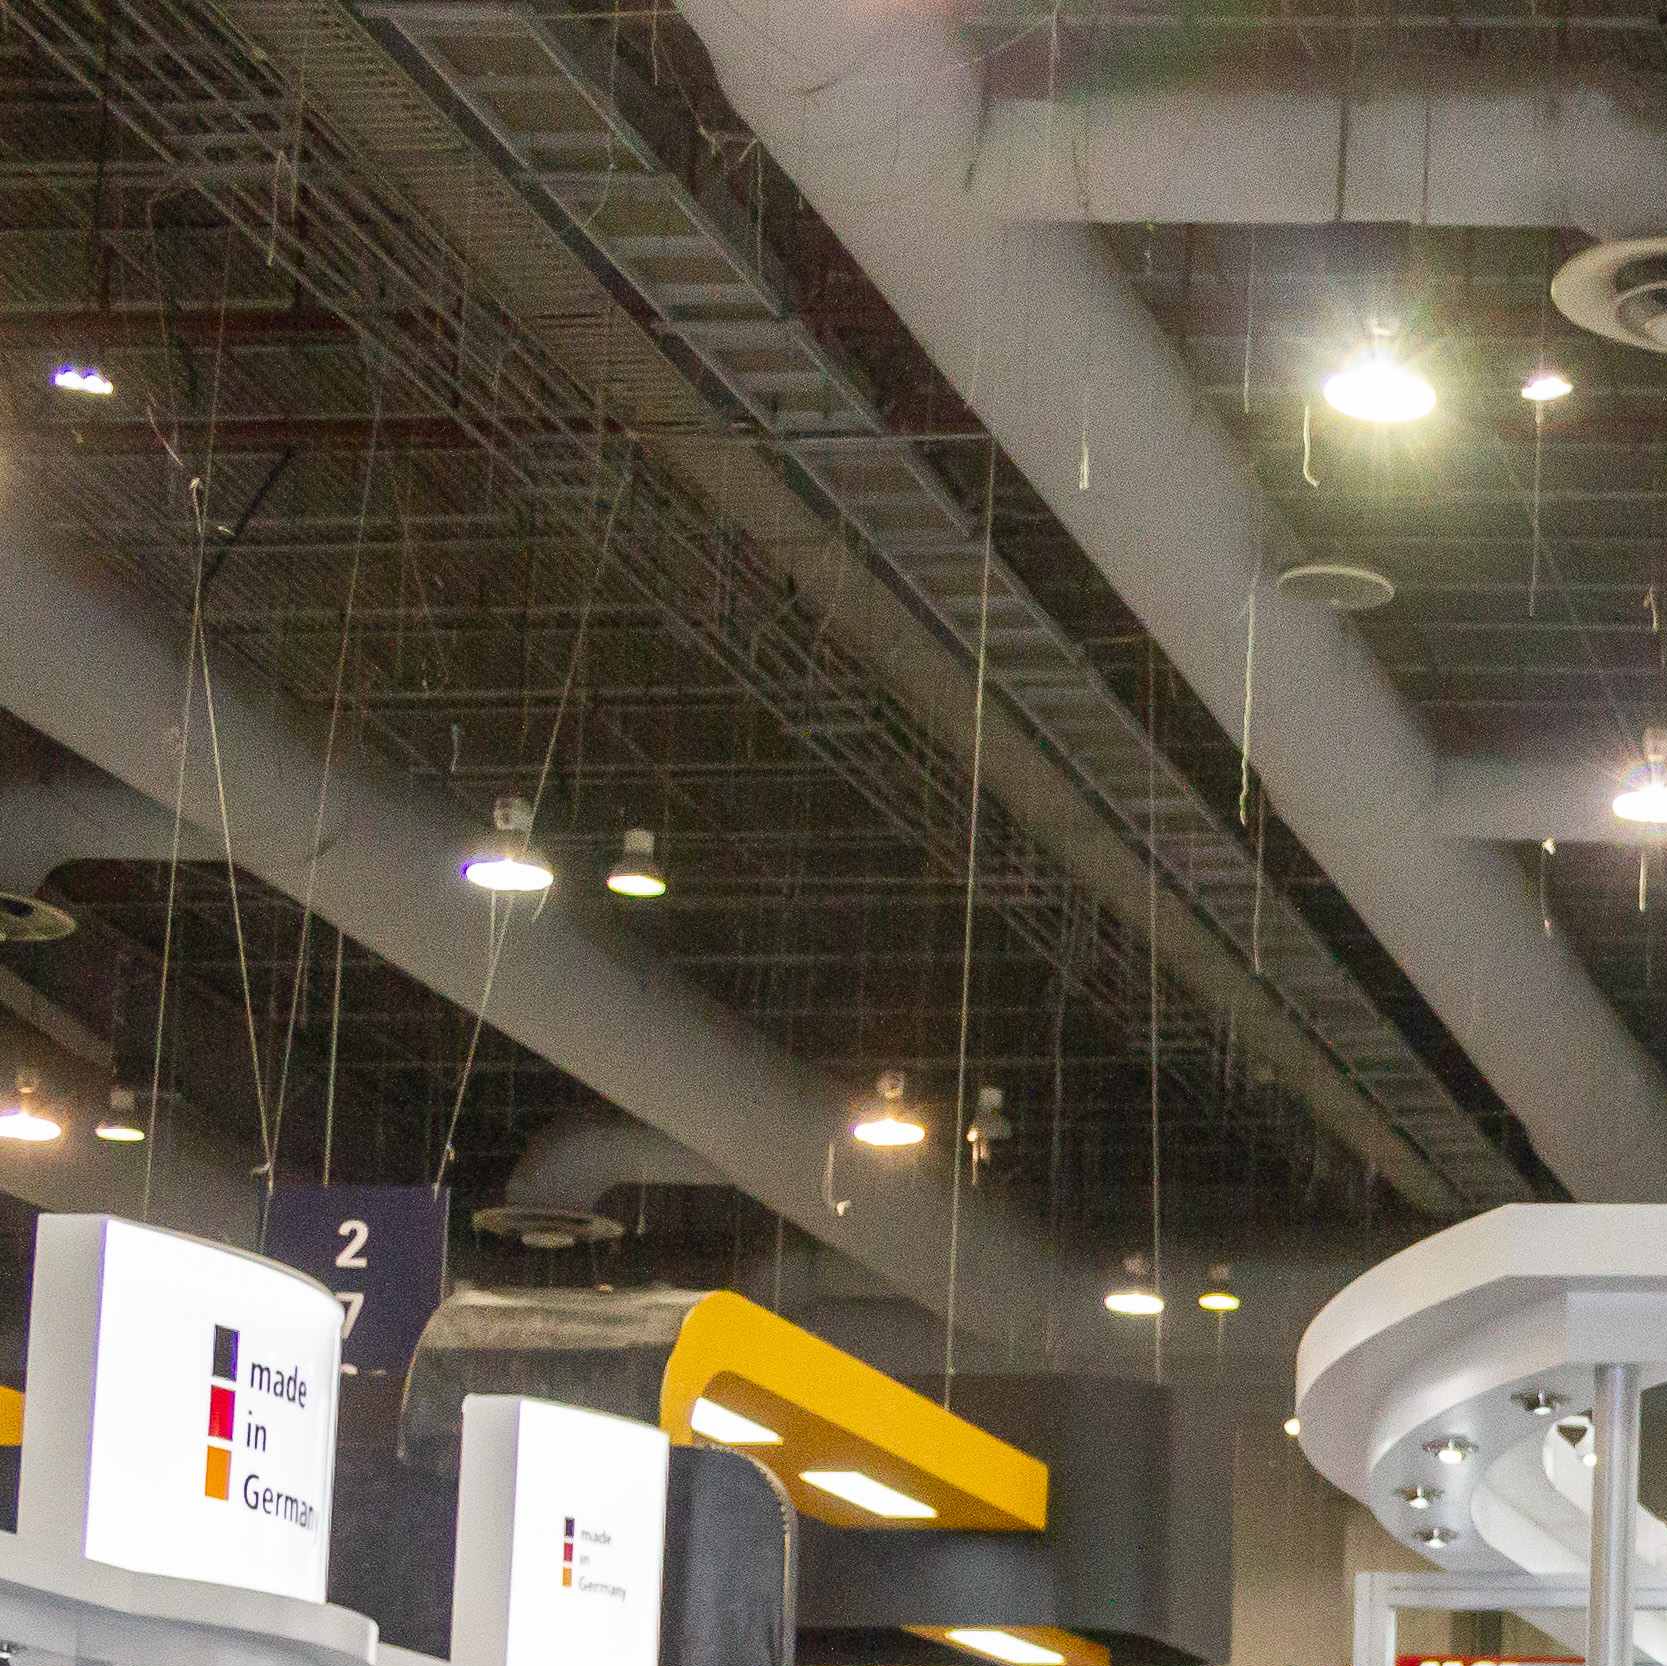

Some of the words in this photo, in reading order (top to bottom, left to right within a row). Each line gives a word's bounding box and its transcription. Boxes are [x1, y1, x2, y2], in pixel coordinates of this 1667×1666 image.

[334, 1218, 369, 1269] 2
[335, 1291, 365, 1341] 7
[250, 1361, 308, 1409] made
[246, 1409, 268, 1452] in
[580, 1528, 612, 1545] made
[578, 1574, 627, 1602] Germany
